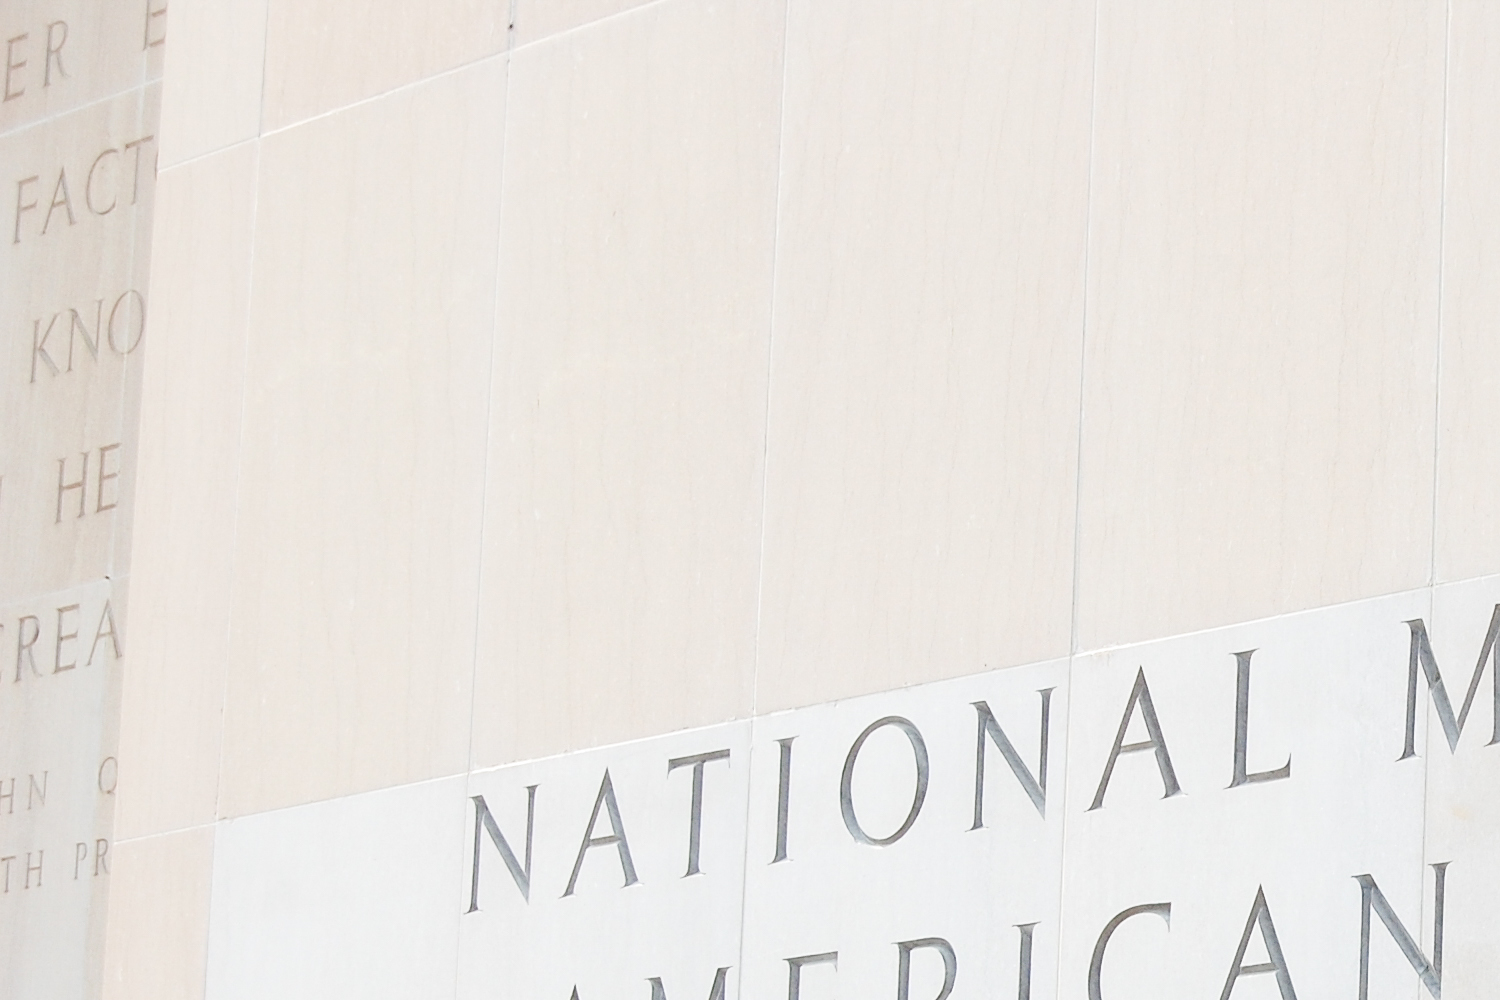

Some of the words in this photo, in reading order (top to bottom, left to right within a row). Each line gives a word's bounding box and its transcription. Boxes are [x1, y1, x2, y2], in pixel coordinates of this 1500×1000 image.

[4, 32, 72, 101] ER
[13, 135, 159, 245] FACT
[29, 289, 146, 384] KNO
[55, 443, 121, 525] HE
[0, 599, 122, 683] REA
[463, 648, 1293, 916] NATIONAL
